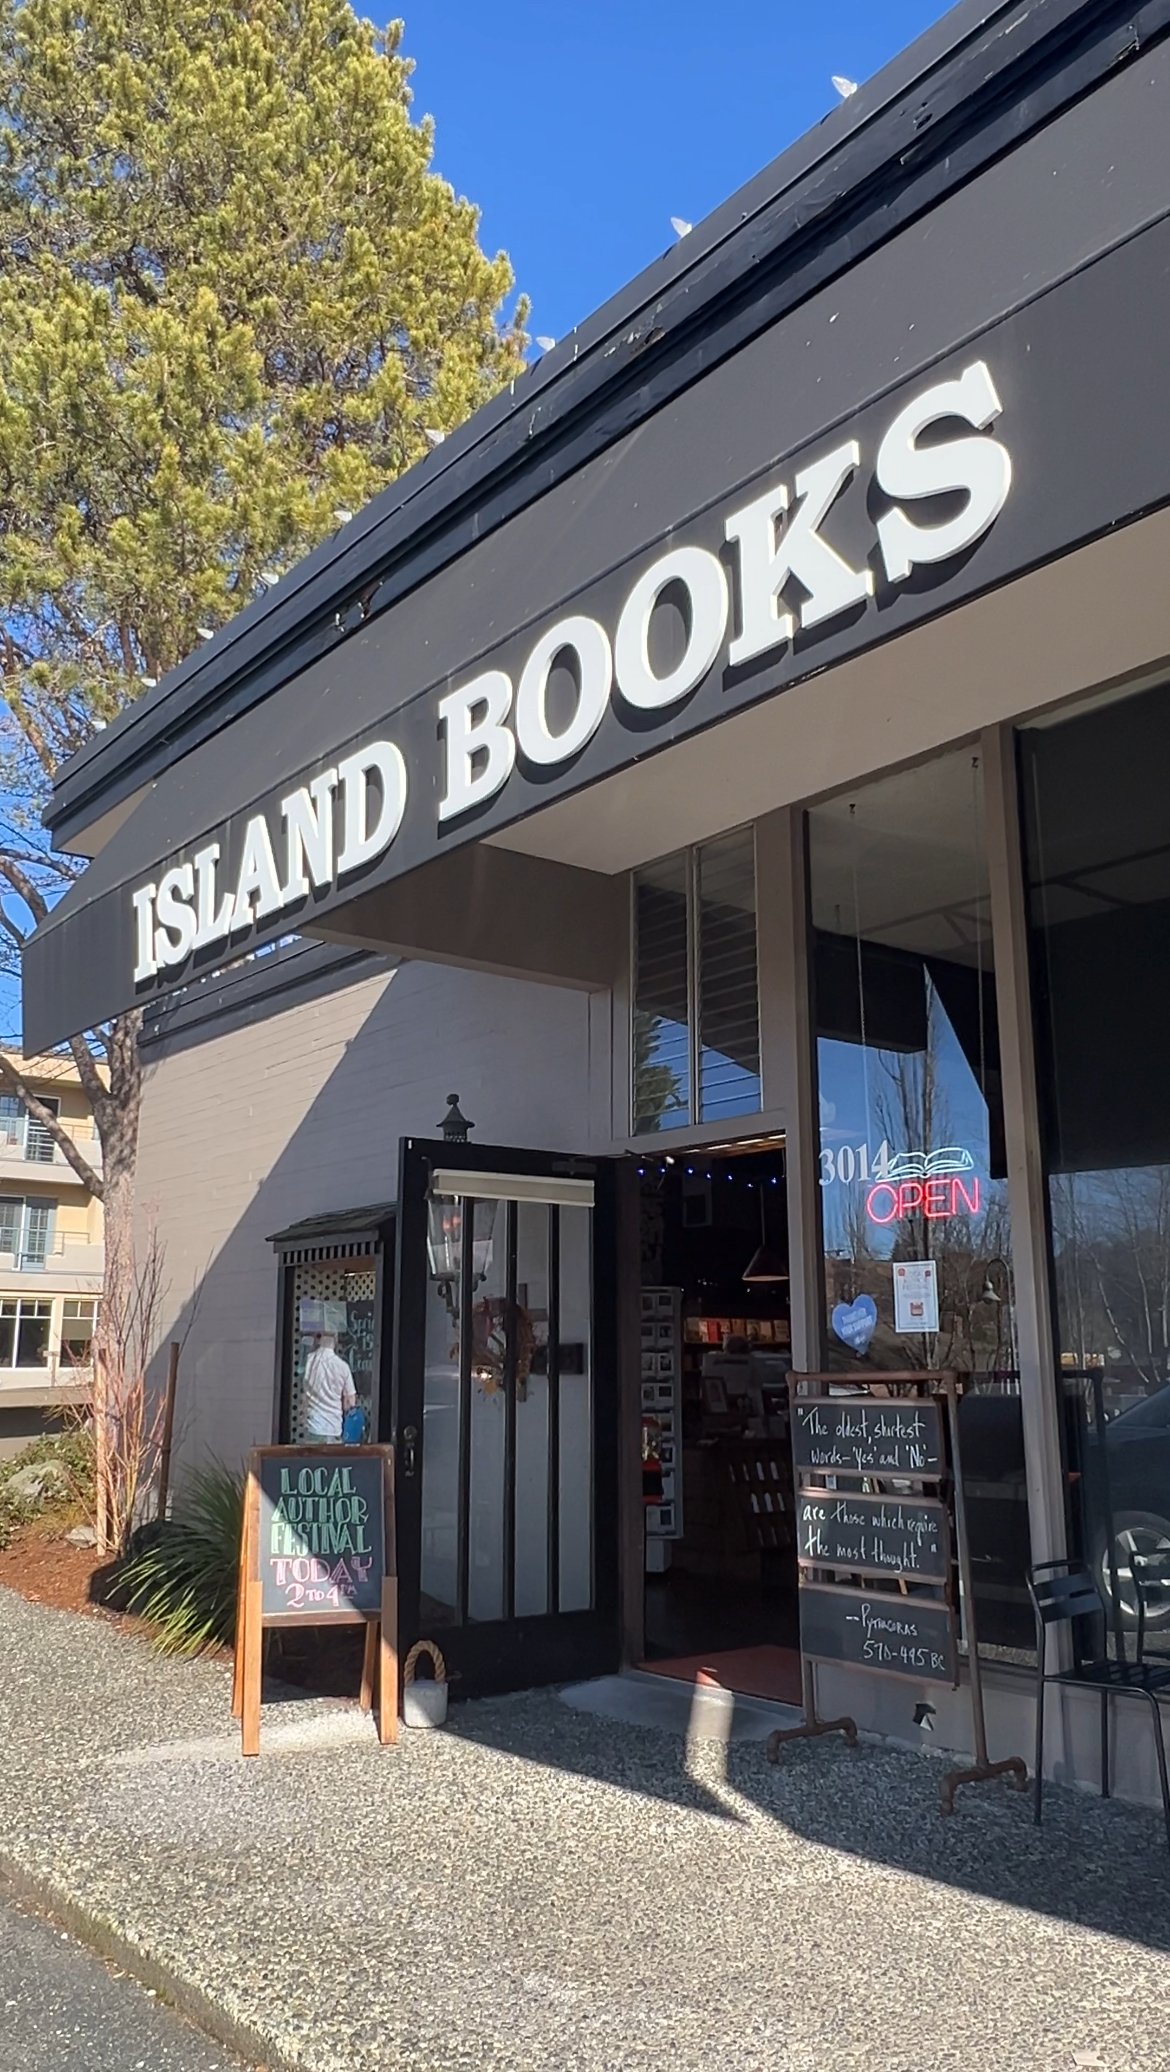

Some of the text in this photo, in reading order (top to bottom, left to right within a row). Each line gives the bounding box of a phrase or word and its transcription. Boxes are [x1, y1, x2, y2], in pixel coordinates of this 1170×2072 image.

[132, 361, 1014, 984] ISLAND BOOKS
[818, 1140, 890, 1186] 3014
[866, 1178, 981, 1223] OPEN
[879, 1444, 900, 1467] and
[280, 1466, 357, 1497] LOCAL
[270, 1496, 370, 1525] AUTHOR
[802, 1504, 826, 1521] are
[830, 1500, 866, 1526] those
[871, 1504, 905, 1530] which
[270, 1521, 373, 1557] FESTIVAL
[804, 1524, 831, 1557] the
[836, 1535, 867, 1560] most
[269, 1555, 373, 1587] TODAY
[284, 1583, 305, 1609] 2
[930, 1652, 946, 1671] BC
